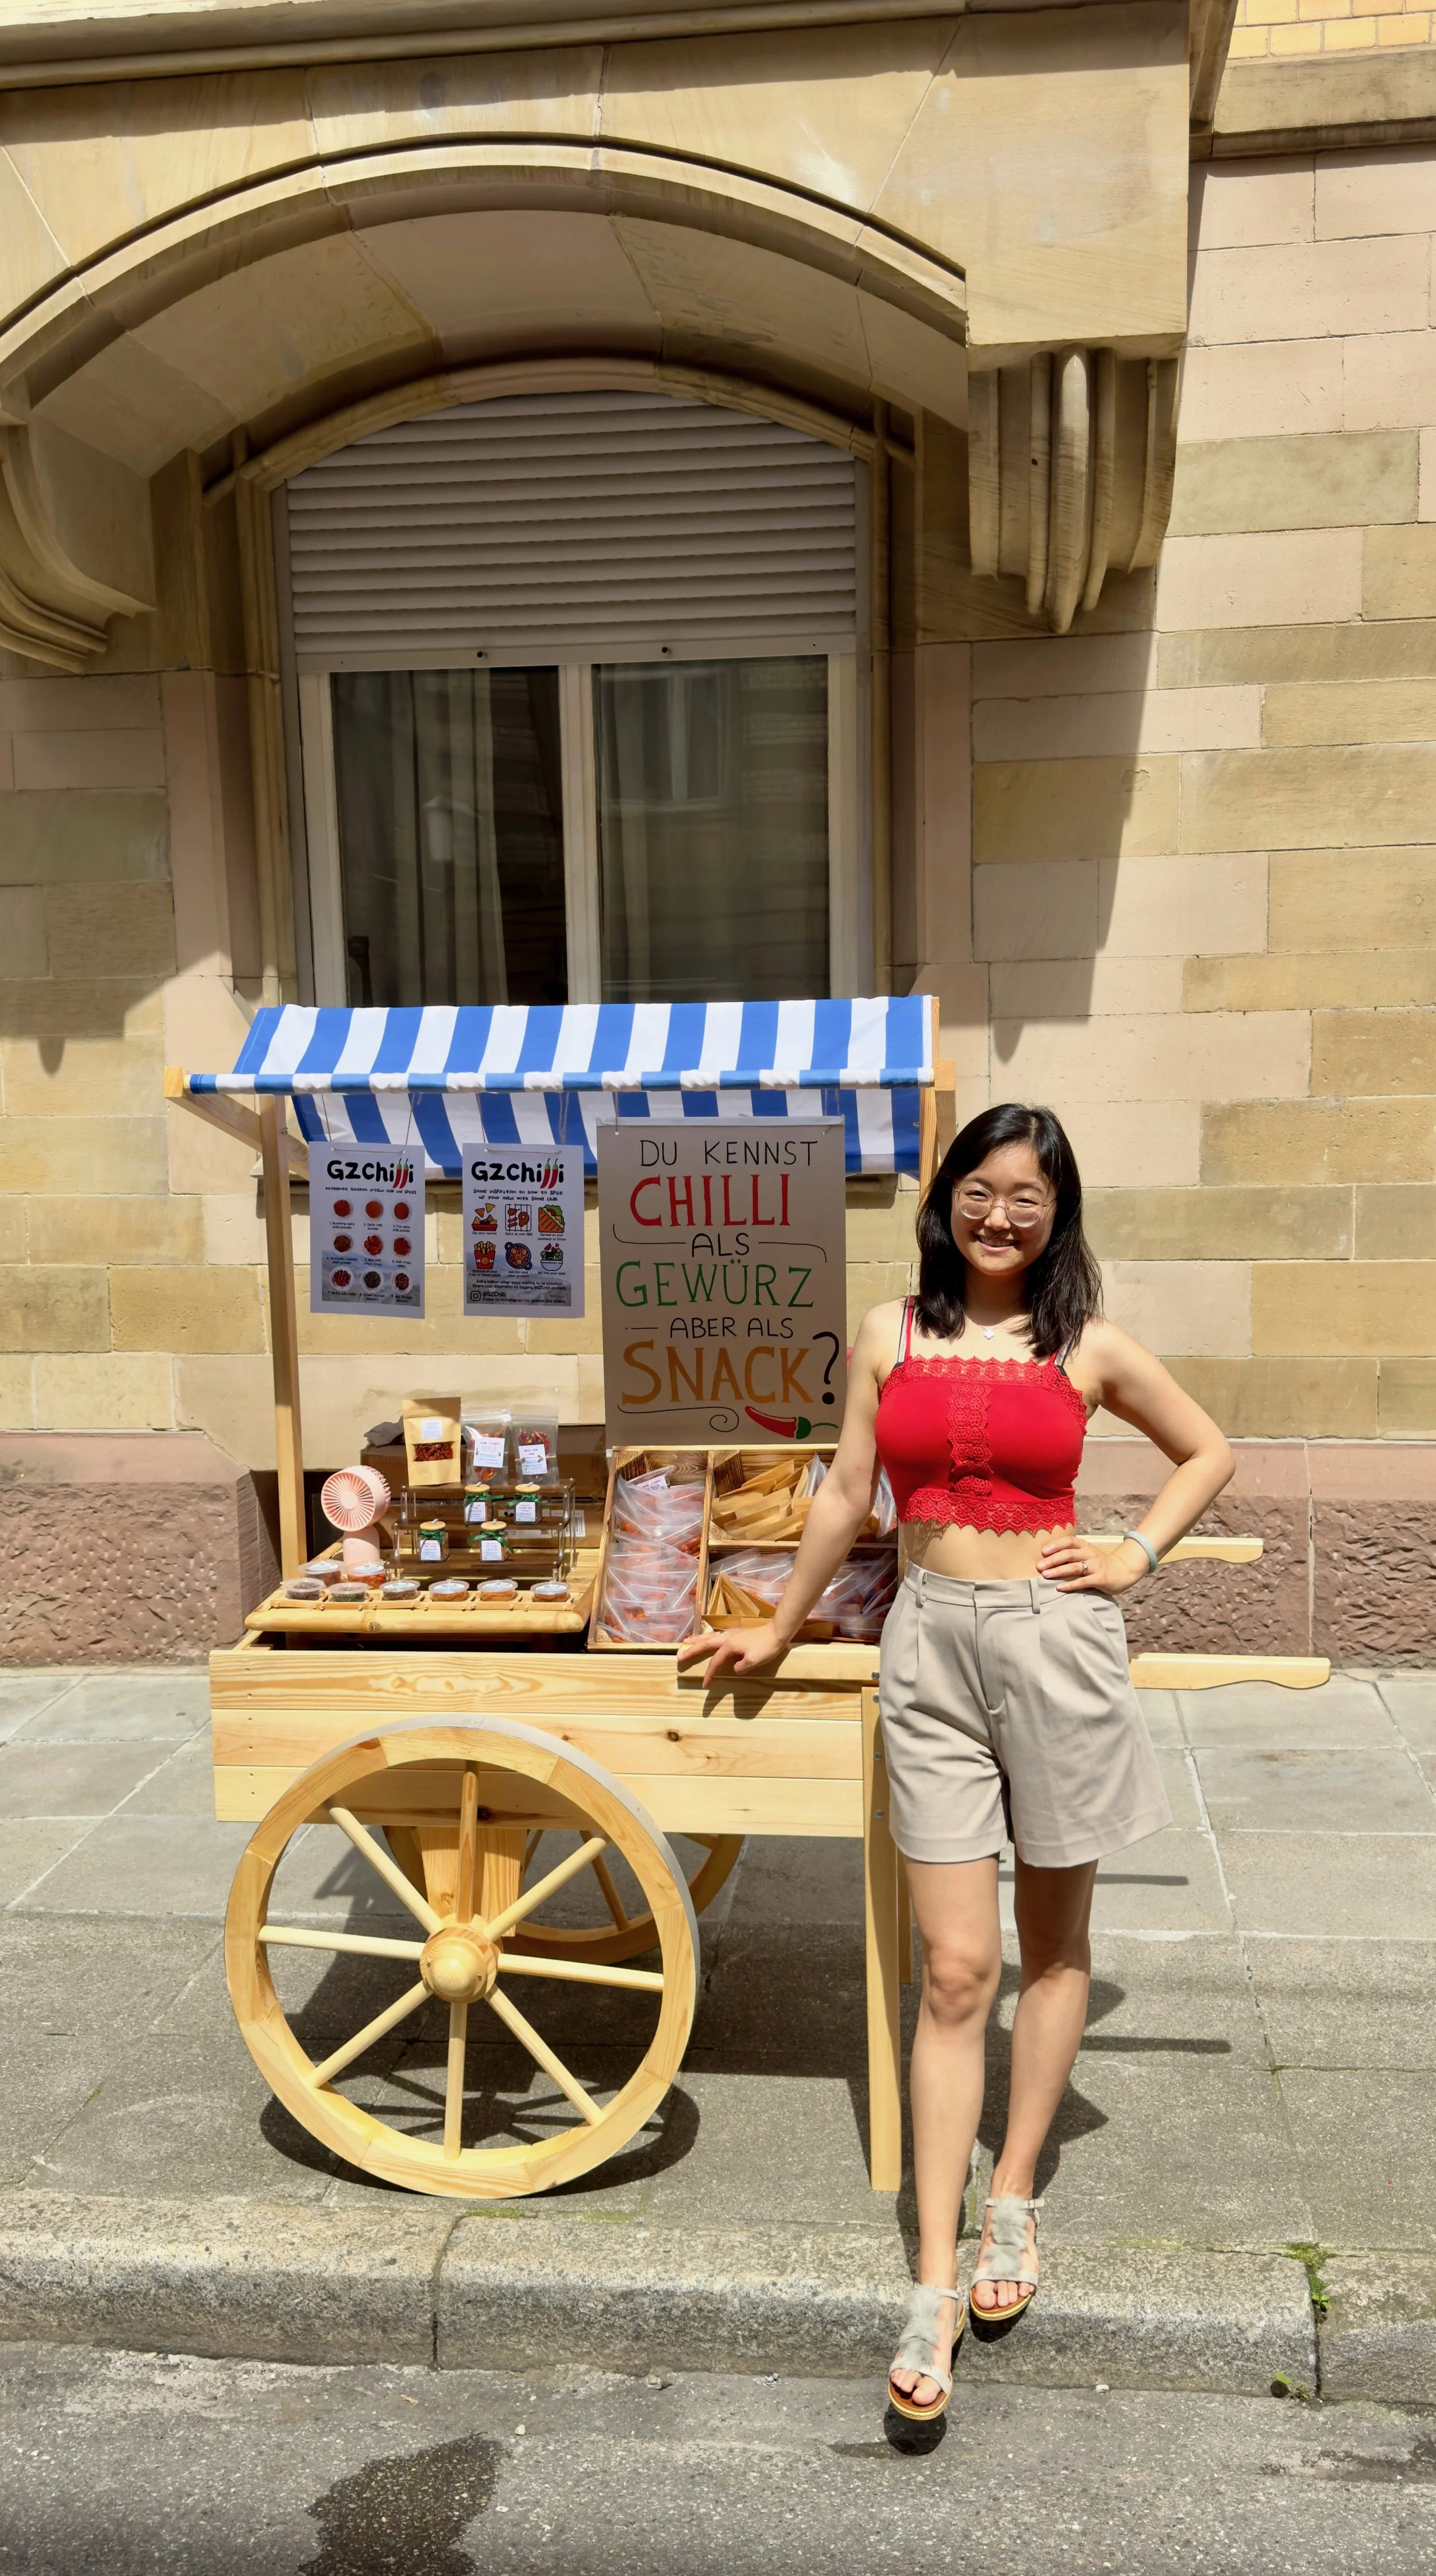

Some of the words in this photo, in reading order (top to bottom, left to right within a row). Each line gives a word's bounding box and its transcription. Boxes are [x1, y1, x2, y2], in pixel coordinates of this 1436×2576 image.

[639, 1139, 677, 1167] DU
[704, 1140, 818, 1167] KENNST
[327, 1158, 414, 1189] GZChilli
[471, 1158, 564, 1189] GZChilli
[630, 1174, 791, 1227] CHILLI
[691, 1232, 750, 1258] ALS
[616, 1259, 814, 1308] GEWÜRZ
[670, 1317, 737, 1339] ABER
[747, 1317, 794, 1339] ALS
